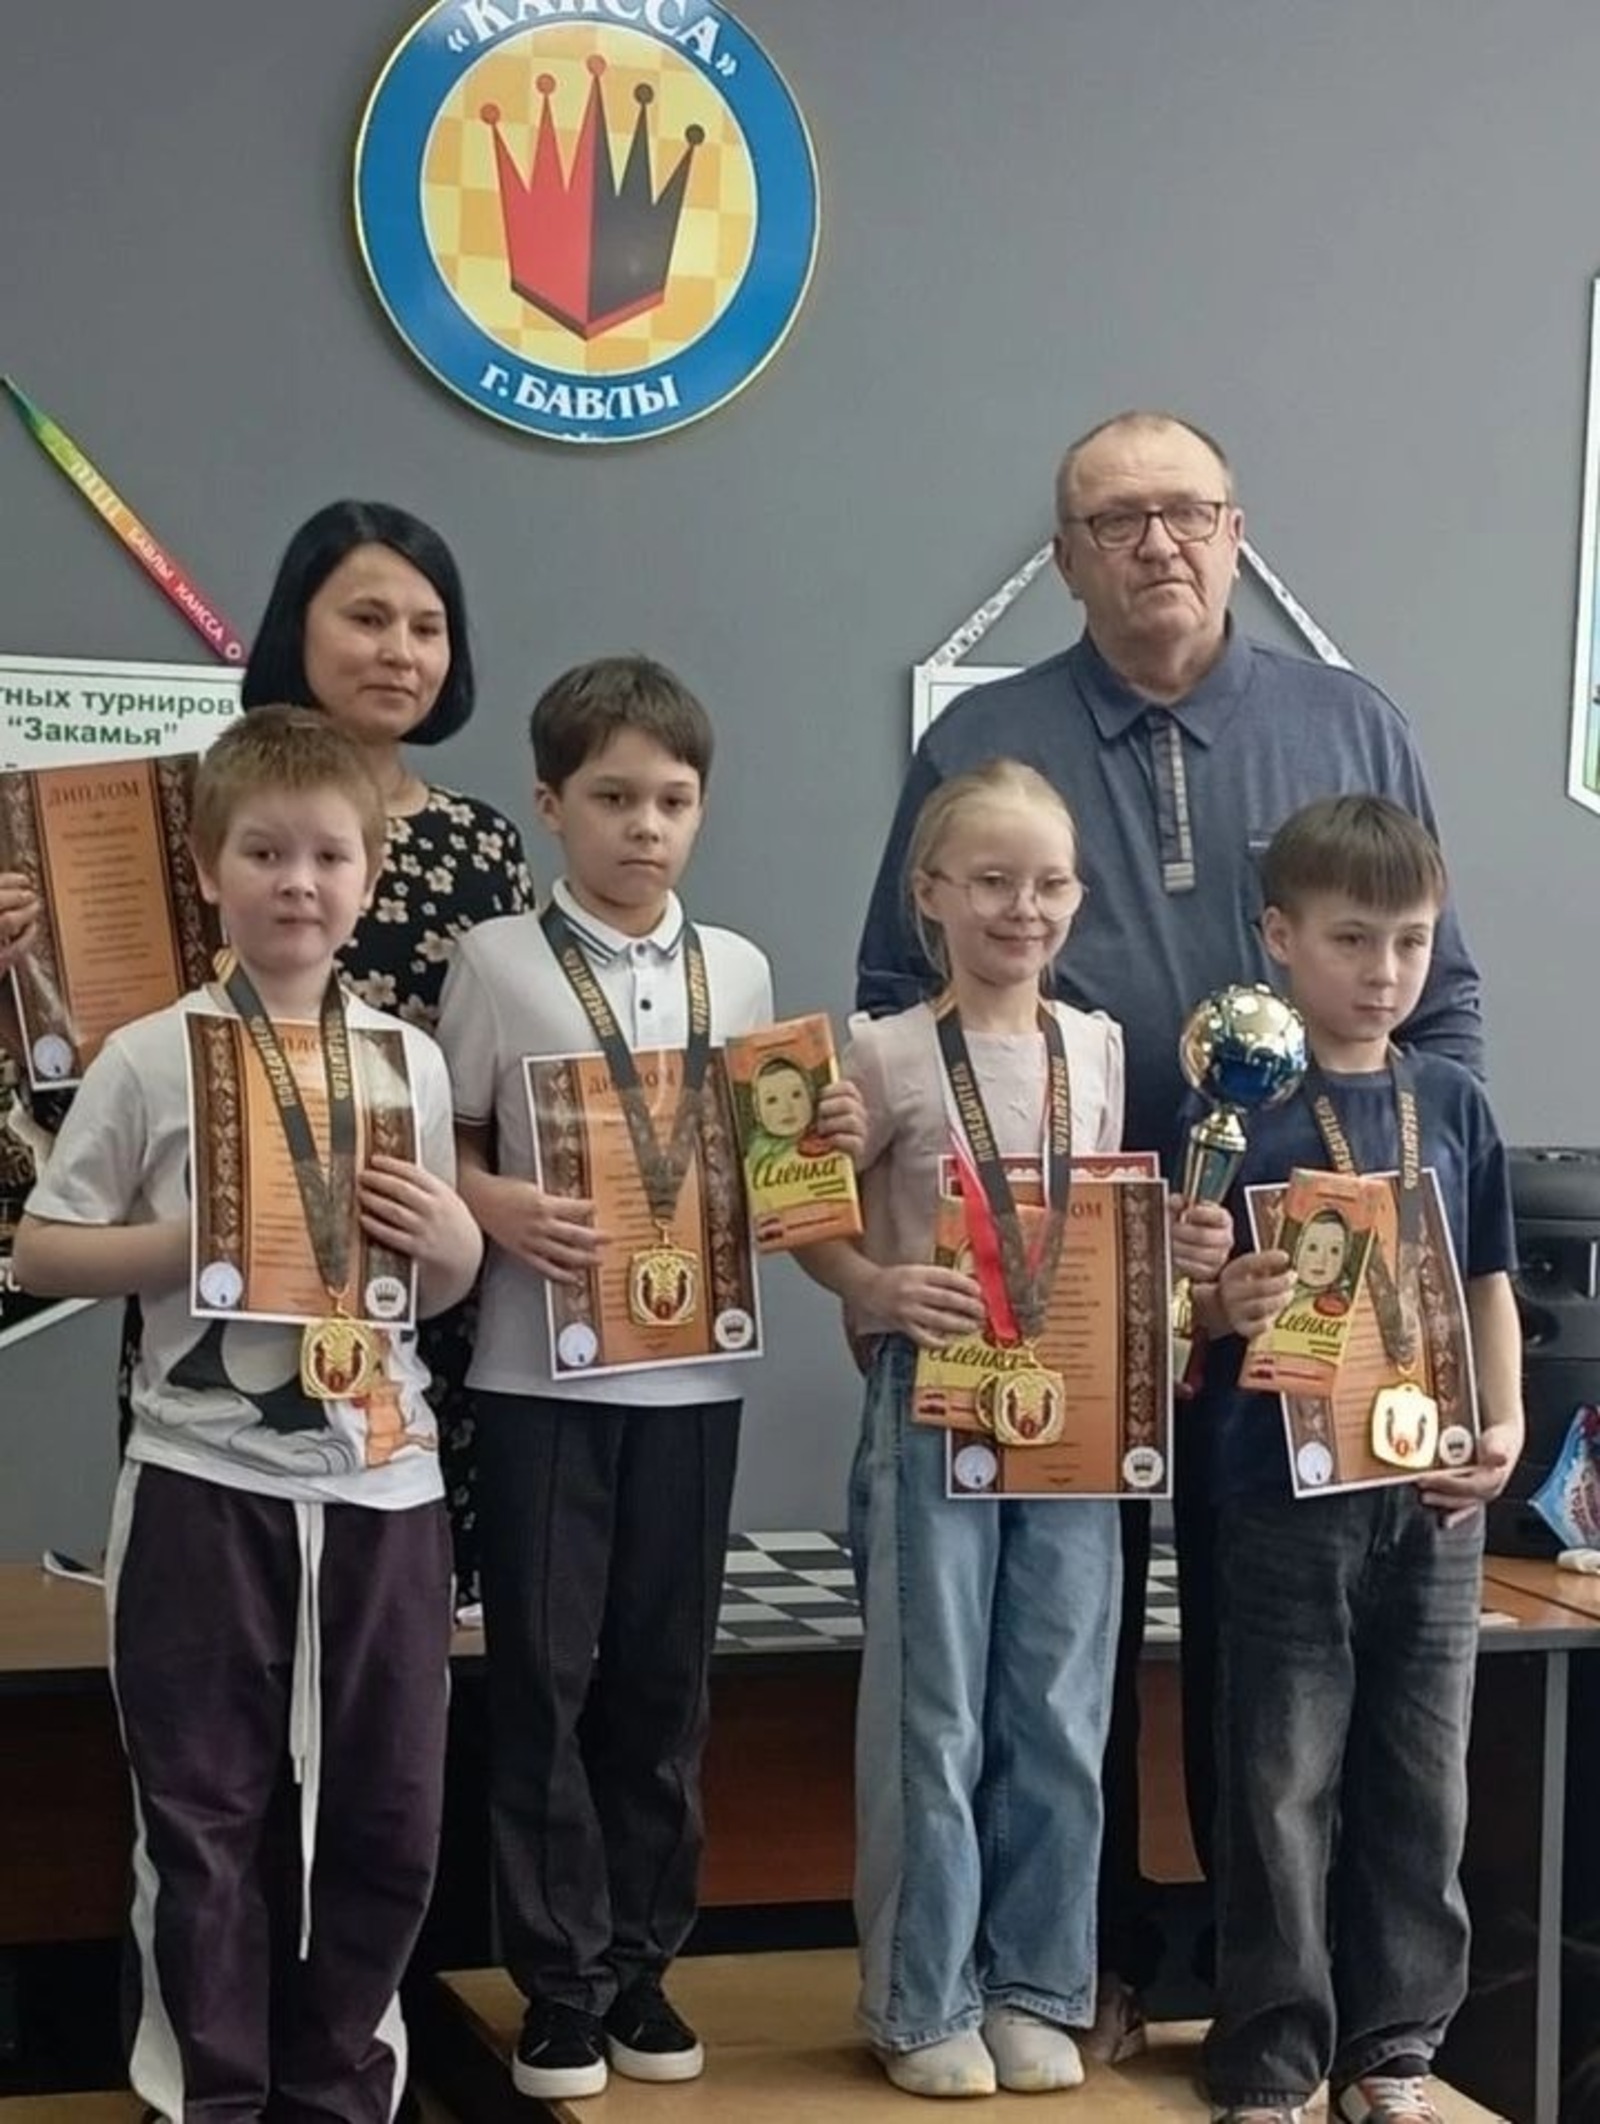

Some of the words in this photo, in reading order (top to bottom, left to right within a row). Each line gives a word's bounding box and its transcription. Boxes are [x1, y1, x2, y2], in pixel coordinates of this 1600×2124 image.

[513, 373, 681, 420] БАВЛЫ
[81, 690, 235, 719] турниров
[1314, 1095, 1355, 1174] БЕДИТЕЛЬ
